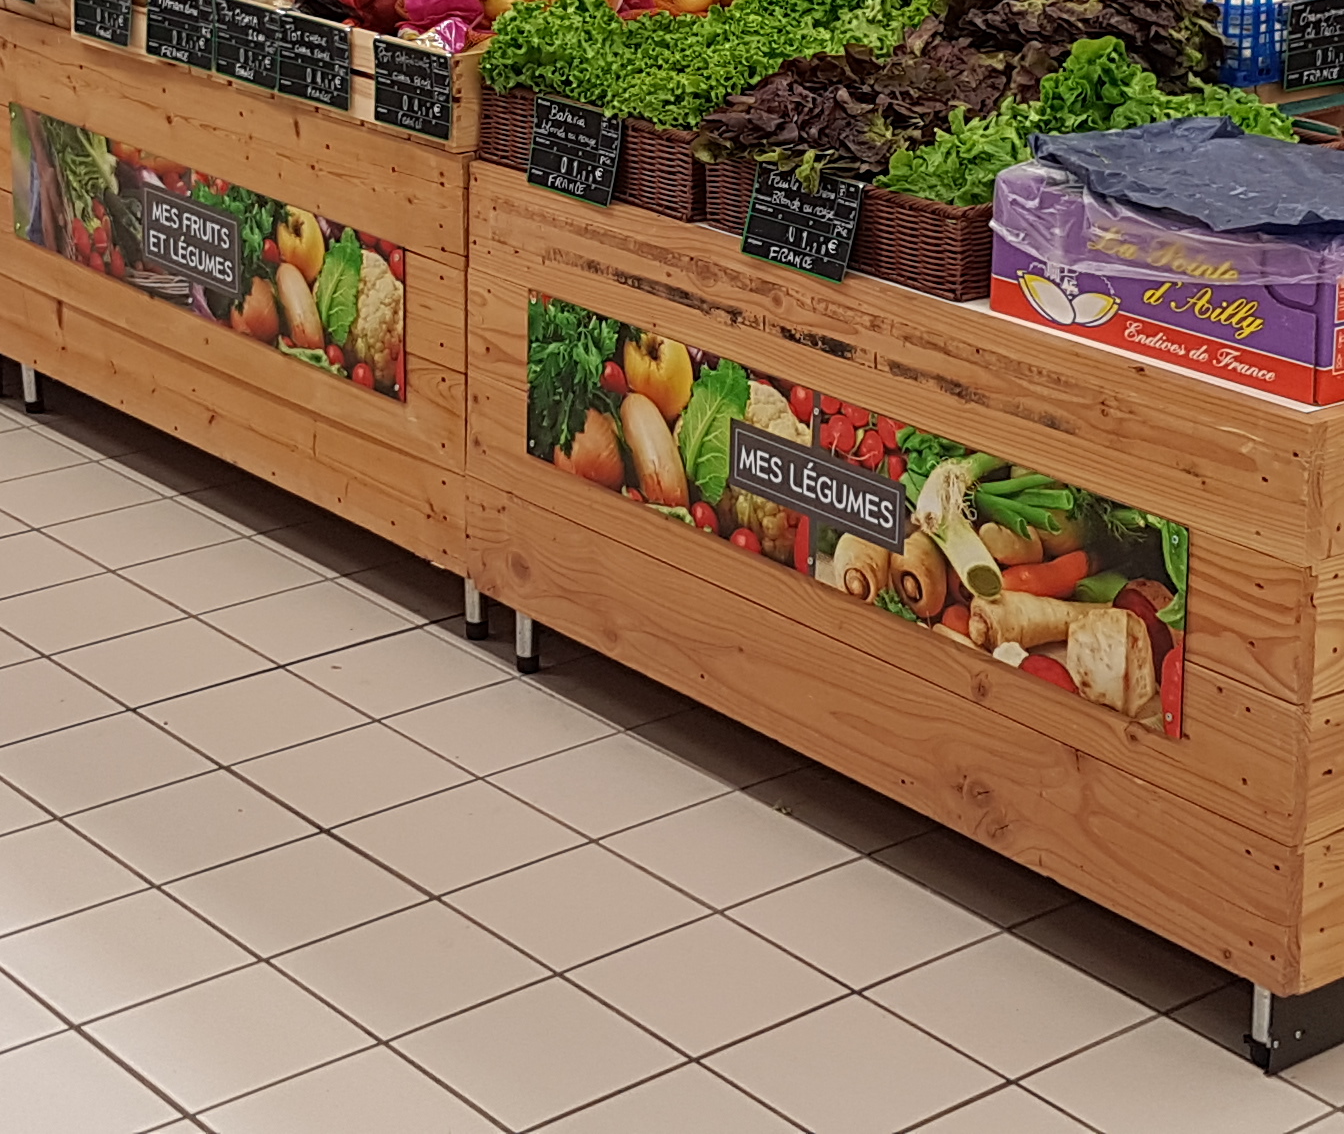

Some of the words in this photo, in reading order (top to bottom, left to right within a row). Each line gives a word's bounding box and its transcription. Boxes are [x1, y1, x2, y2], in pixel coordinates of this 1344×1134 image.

[547, 173, 585, 196] FRANCE
[152, 202, 179, 229] MES
[182, 212, 230, 249] FRUITS
[149, 230, 167, 254] ET
[170, 235, 233, 282] LÉGUMES
[768, 246, 814, 269] FRANCE
[1143, 281, 1265, 340] d'Ailly
[1123, 321, 1186, 356] Endives
[1189, 345, 1209, 363] de
[1212, 347, 1277, 383] France
[739, 444, 783, 484] MES
[789, 462, 894, 529] LÉGUMES
